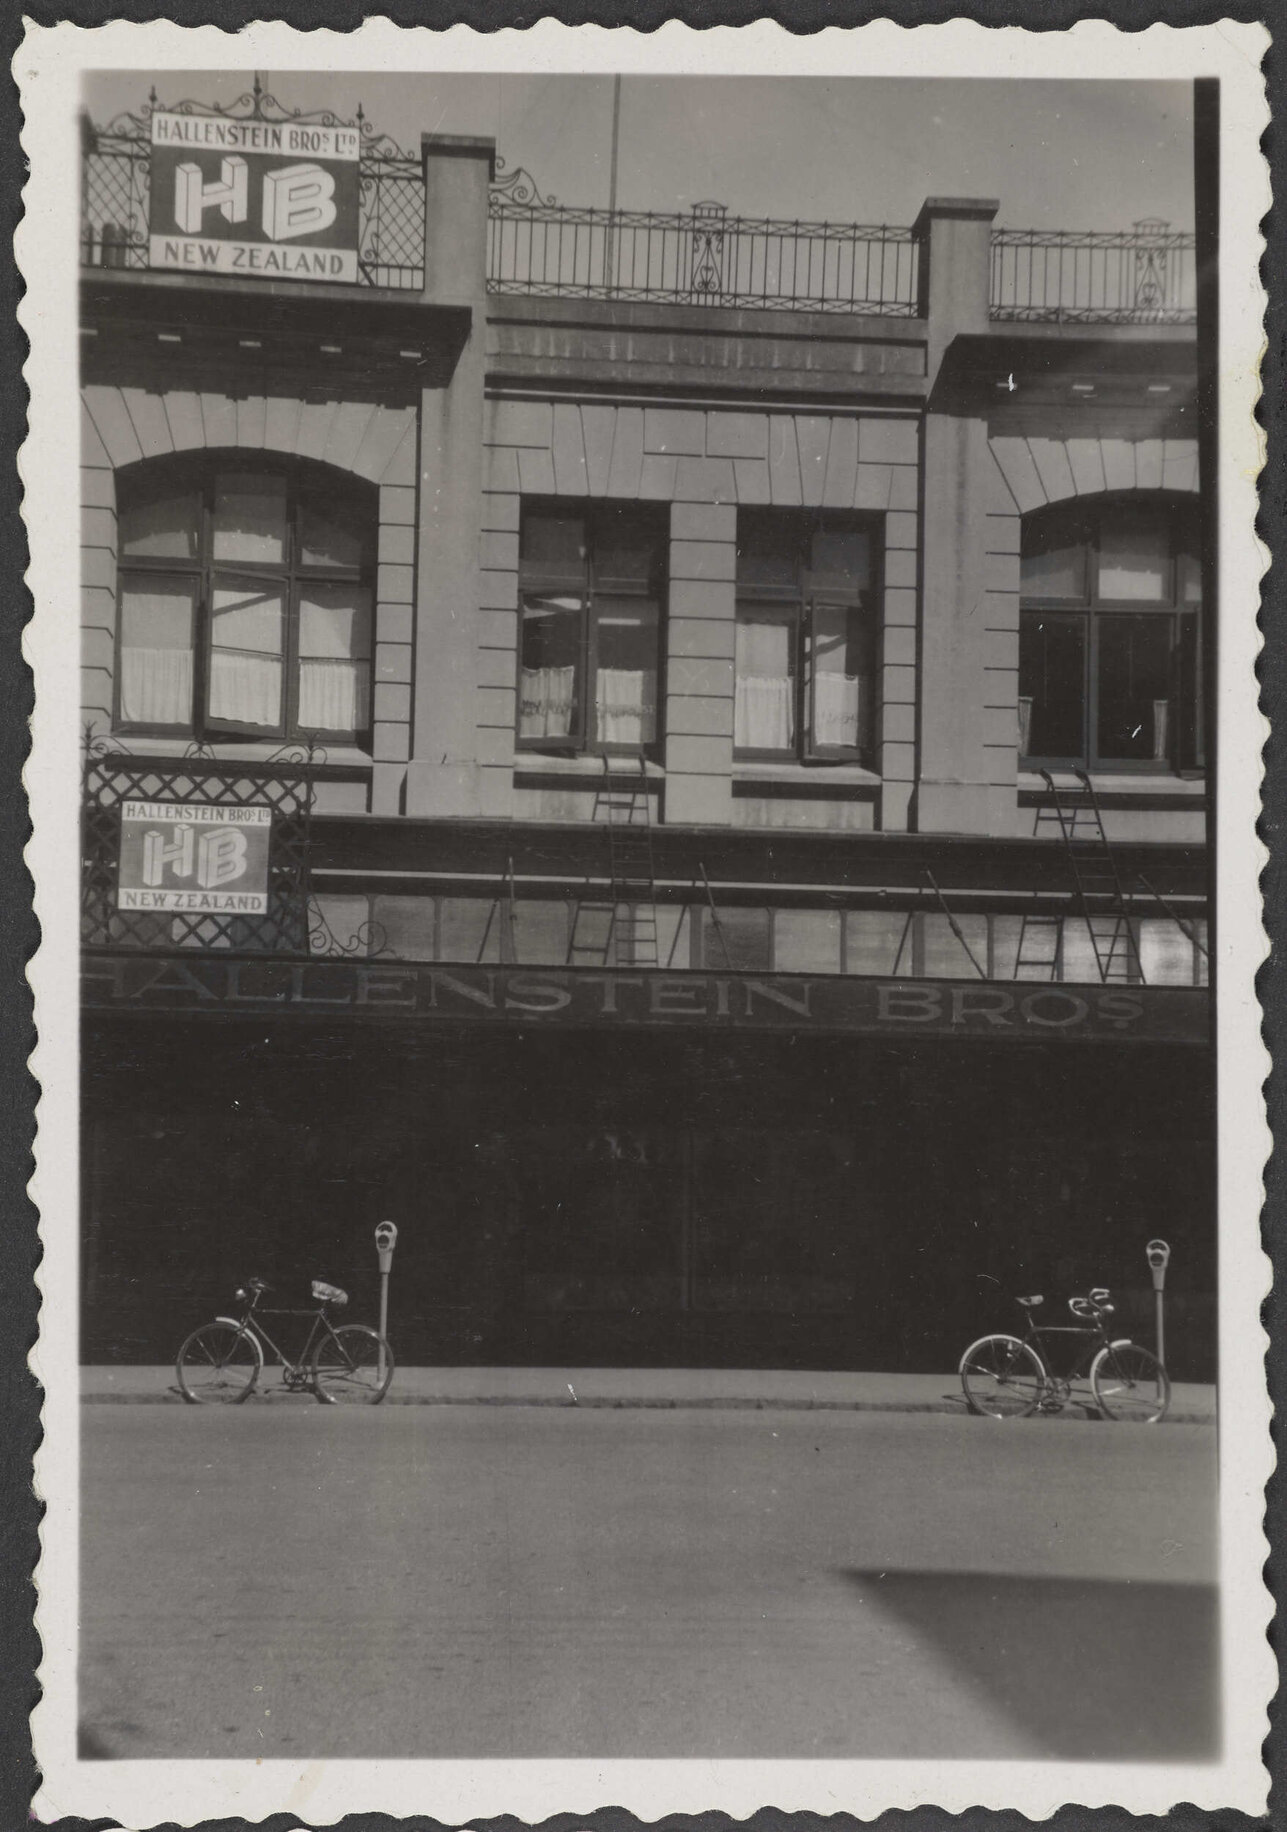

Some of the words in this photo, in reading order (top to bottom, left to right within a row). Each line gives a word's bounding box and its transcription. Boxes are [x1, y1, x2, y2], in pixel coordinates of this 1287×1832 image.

[157, 119, 282, 149] HALLENSTEIN
[174, 155, 338, 242] HB
[164, 241, 221, 265] NEW
[231, 247, 344, 275] ZEALAND
[126, 804, 224, 821] HALLENSTEIN
[142, 823, 248, 889] HB
[125, 891, 167, 908] NEW
[173, 893, 263, 910] ZEALAND
